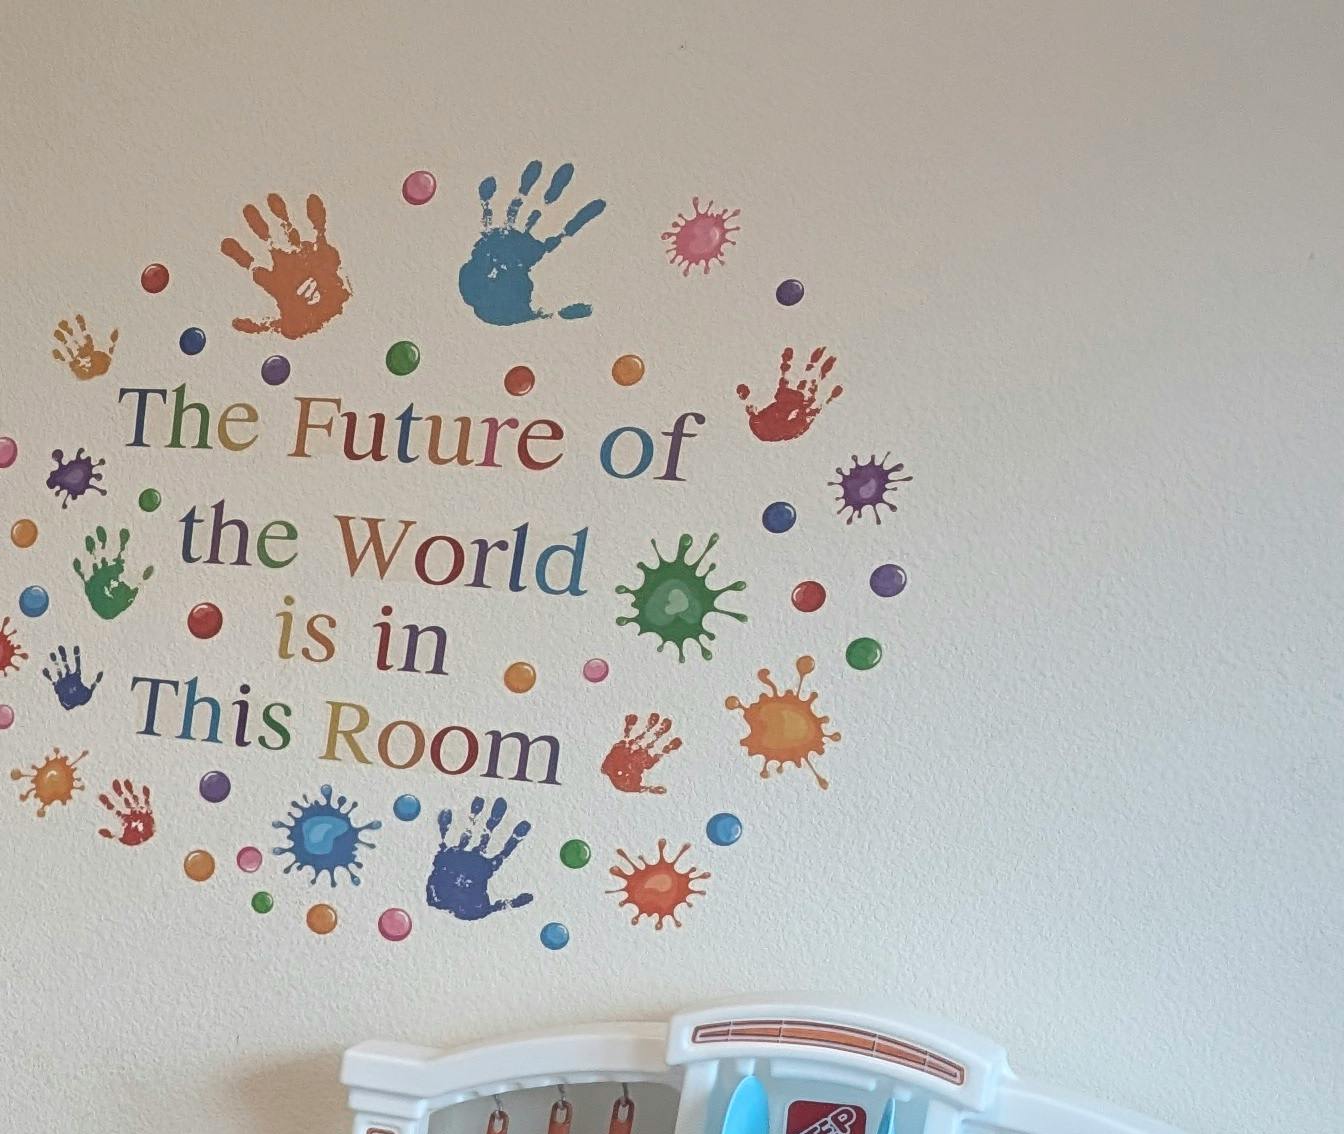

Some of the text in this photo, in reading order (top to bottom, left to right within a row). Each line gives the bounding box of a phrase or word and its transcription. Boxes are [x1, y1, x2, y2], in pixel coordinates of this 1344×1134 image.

[118, 383, 706, 482] The Future of
[178, 499, 590, 597] the World
[275, 595, 449, 676] is in
[130, 675, 562, 786] This Room
